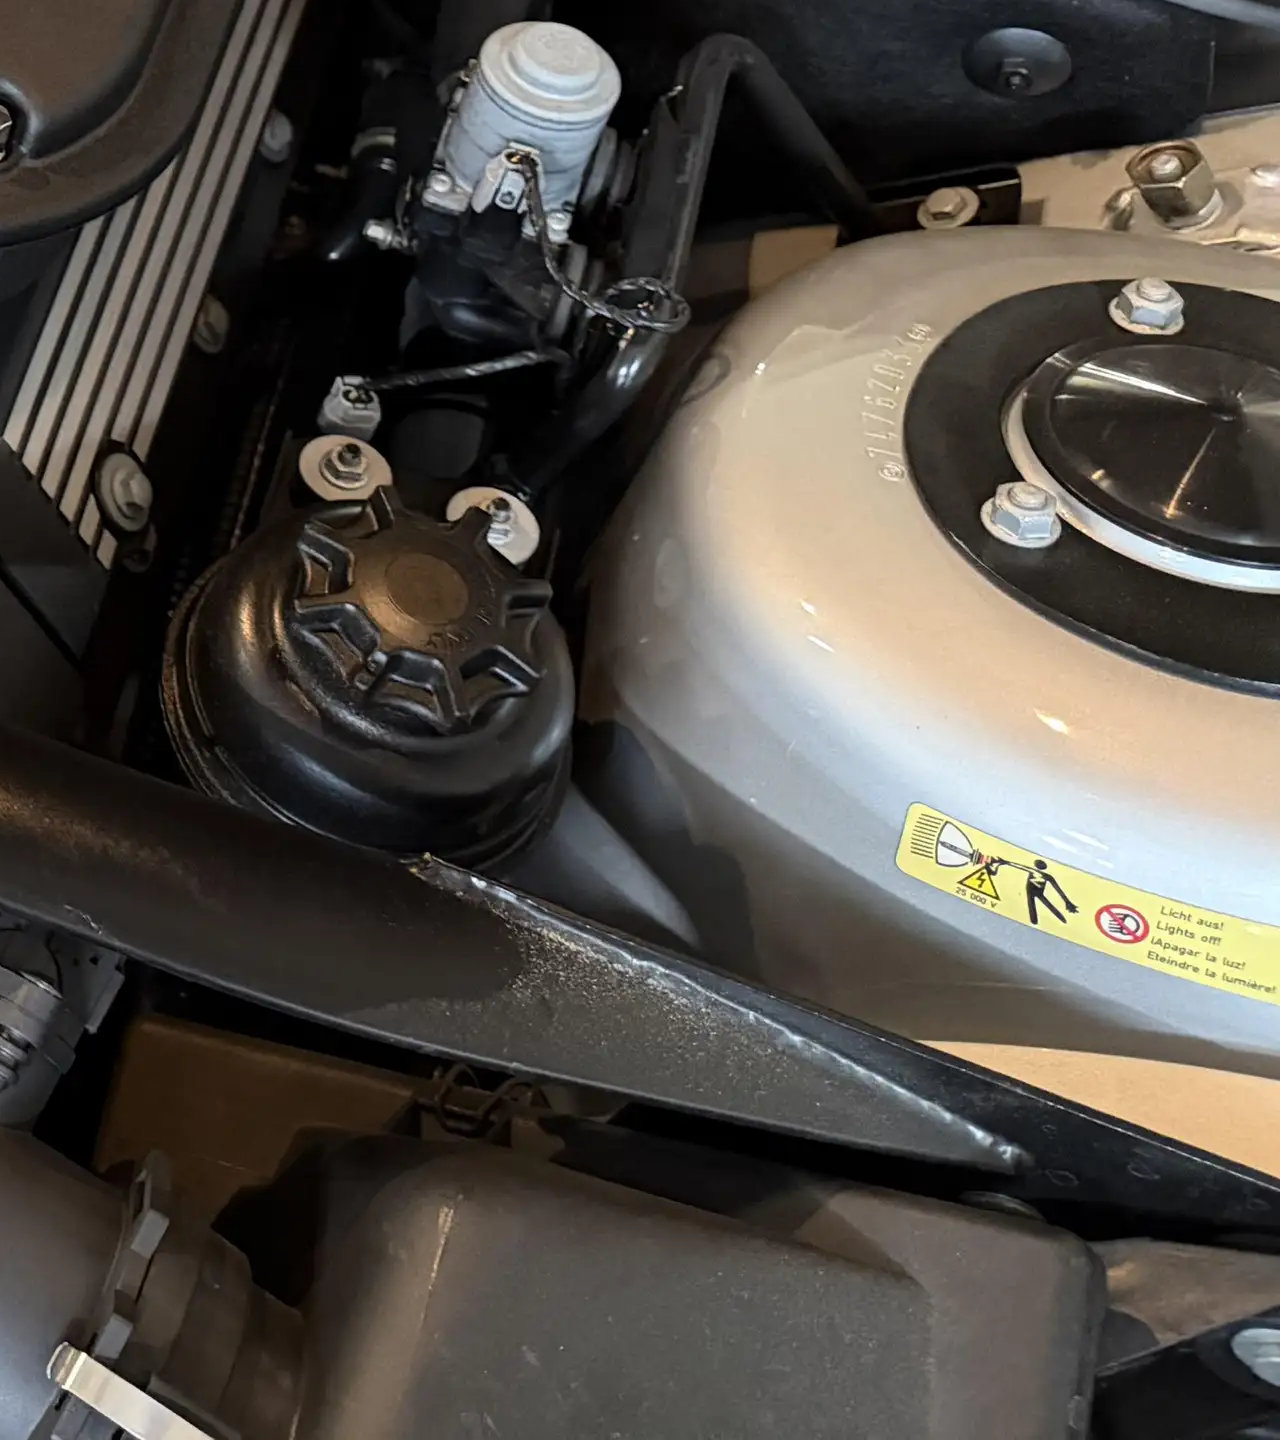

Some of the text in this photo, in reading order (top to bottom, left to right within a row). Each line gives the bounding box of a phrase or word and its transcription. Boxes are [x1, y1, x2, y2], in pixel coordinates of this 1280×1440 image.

[956, 887, 966, 896] 25
[970, 893, 986, 904] 000
[1160, 906, 1224, 930] Licht aus!
[1156, 921, 1221, 945] Lights off!
[1147, 951, 1276, 993] Eteindre la lumière!
[1205, 952, 1217, 962] la
[1223, 958, 1246, 970] luz!
